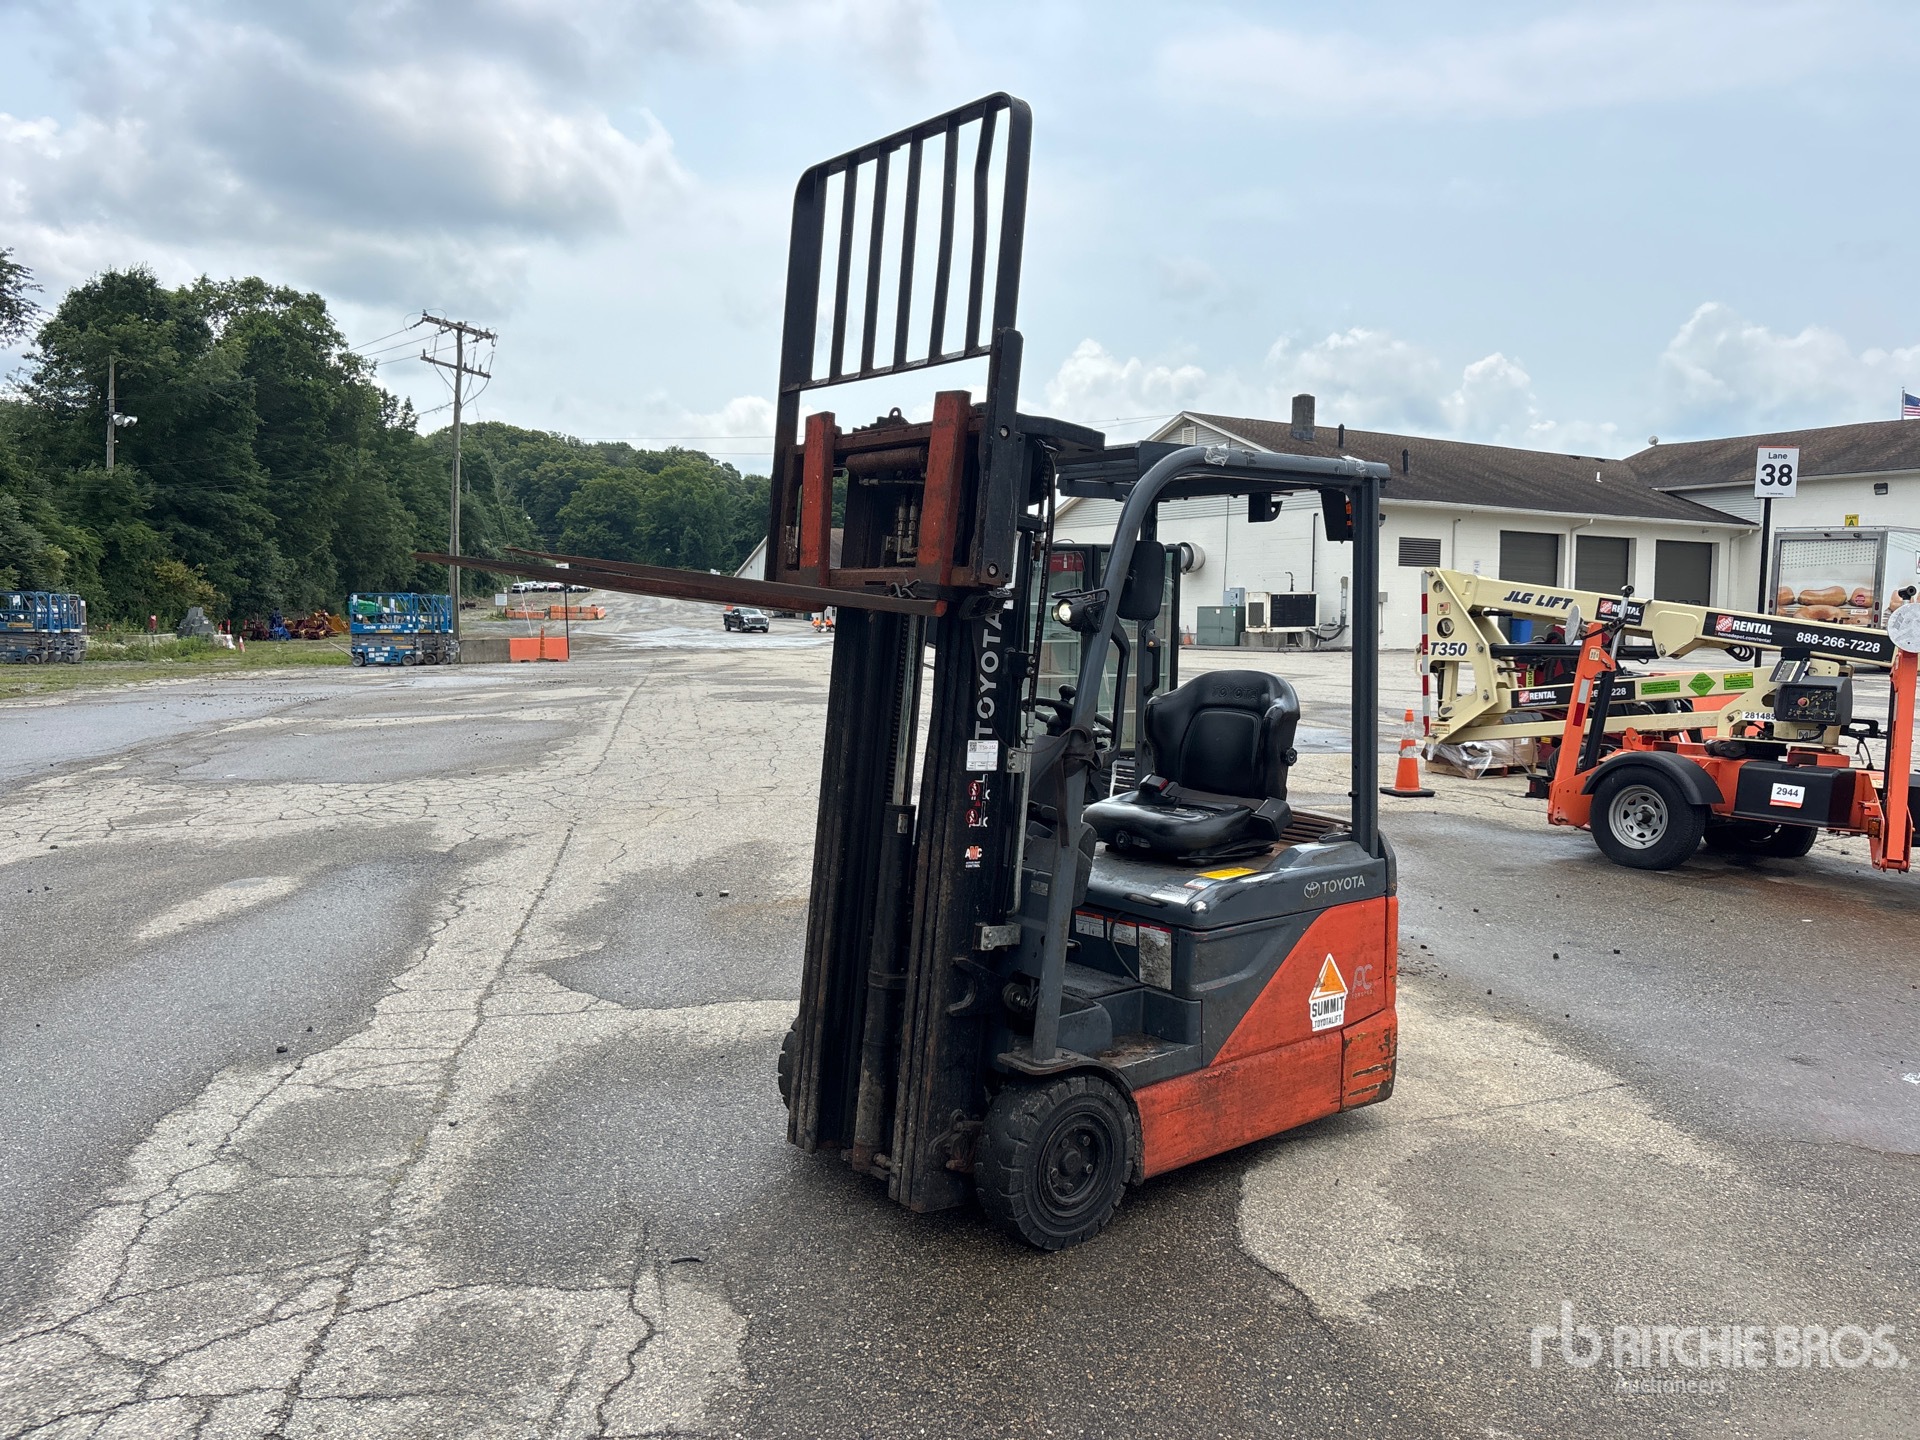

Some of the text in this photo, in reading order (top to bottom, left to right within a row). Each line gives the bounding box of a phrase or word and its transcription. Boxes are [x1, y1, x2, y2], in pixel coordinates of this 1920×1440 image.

[1768, 452, 1788, 460] Lane
[1760, 463, 1793, 486] 38
[1848, 519, 1855, 527] A
[1503, 590, 1574, 610] JLG LIFT
[1611, 604, 1641, 616] RETAL
[1732, 620, 1773, 636] RENTAL
[1430, 642, 1468, 656] T350
[1796, 631, 1881, 654] 888-266-7228
[975, 612, 1002, 739] TOYOTA
[1529, 690, 1557, 700] RENTAL
[1776, 786, 1799, 798] 2944
[1322, 875, 1366, 894] TOYOTA
[1311, 996, 1345, 1018] SUMMIT
